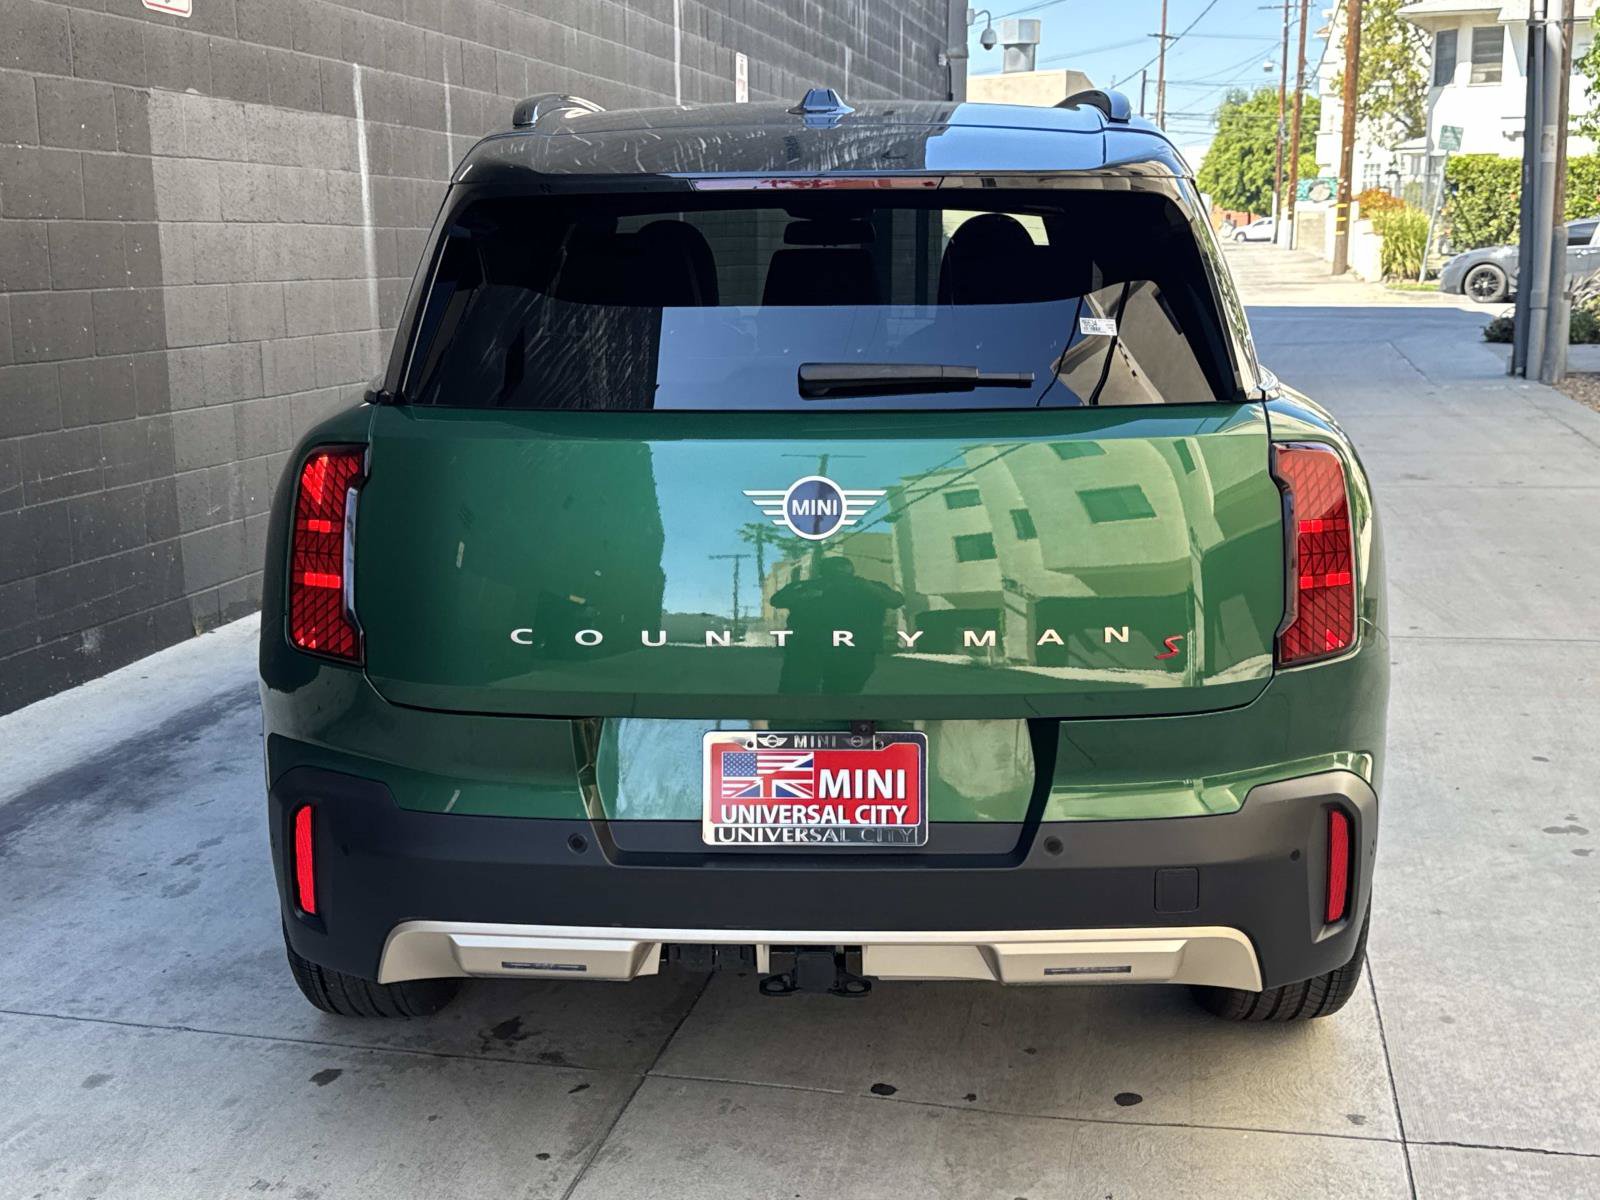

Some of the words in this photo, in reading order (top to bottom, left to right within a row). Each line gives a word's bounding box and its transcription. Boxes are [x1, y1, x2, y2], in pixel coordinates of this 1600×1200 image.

[791, 499, 838, 516] MINI
[510, 626, 1130, 648] COUNTRYMAN
[793, 735, 837, 748] MINI
[818, 768, 906, 800] MINI
[721, 804, 851, 825] UNIVERSAL
[854, 804, 908, 825] CITY
[717, 827, 850, 843] UNIVERSAL
[860, 827, 914, 844] CITY
